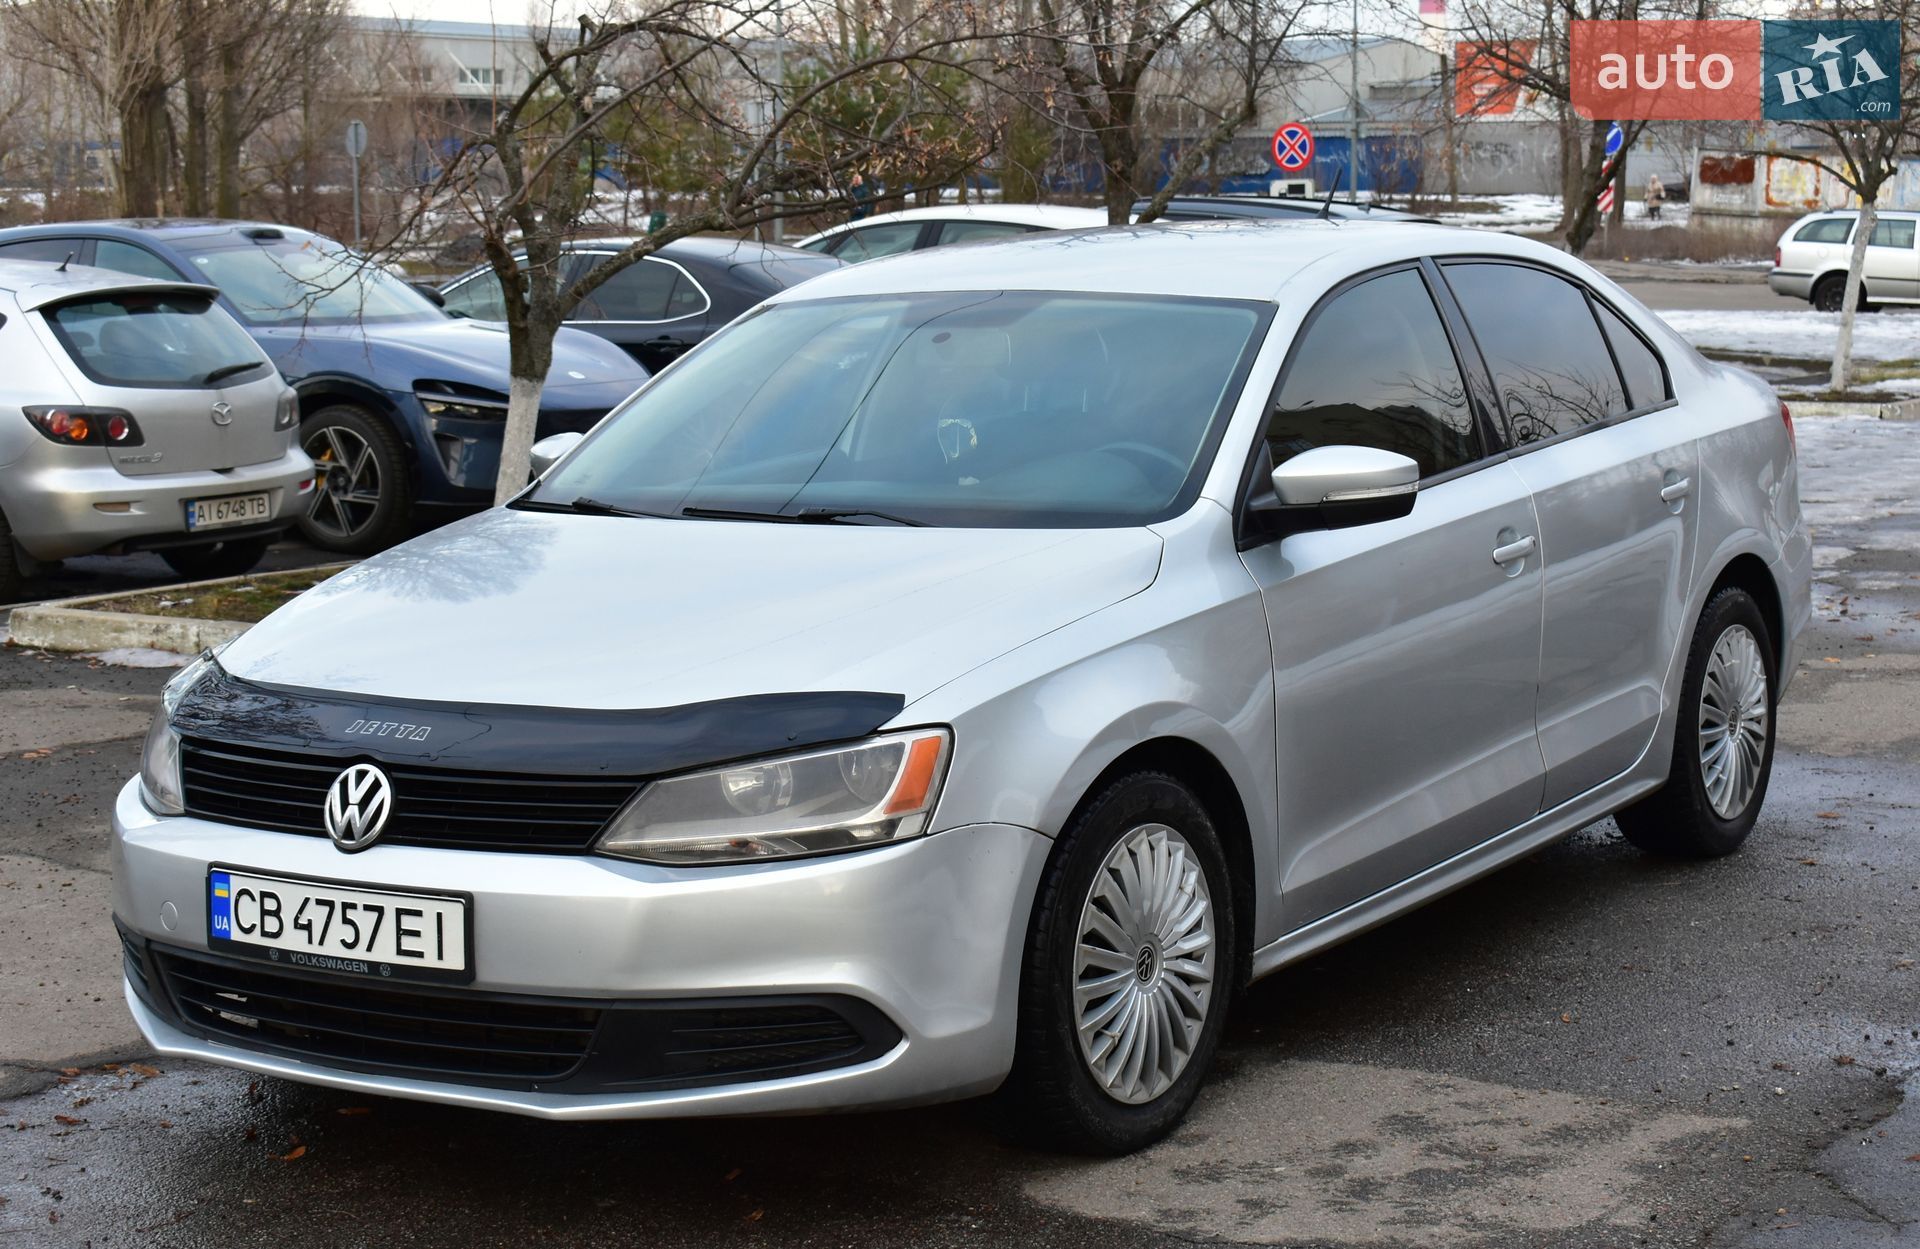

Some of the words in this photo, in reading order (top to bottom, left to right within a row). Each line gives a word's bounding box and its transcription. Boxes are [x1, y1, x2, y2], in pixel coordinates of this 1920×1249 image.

[197, 503, 212, 523] AI
[216, 499, 246, 520] 6748
[248, 496, 267, 516] TB
[345, 719, 432, 741] JETTA
[214, 915, 230, 931] UA
[233, 887, 285, 940] CB
[293, 896, 385, 953] 4757
[395, 906, 444, 961] EI
[290, 952, 369, 974] VOLKSWAGEN
